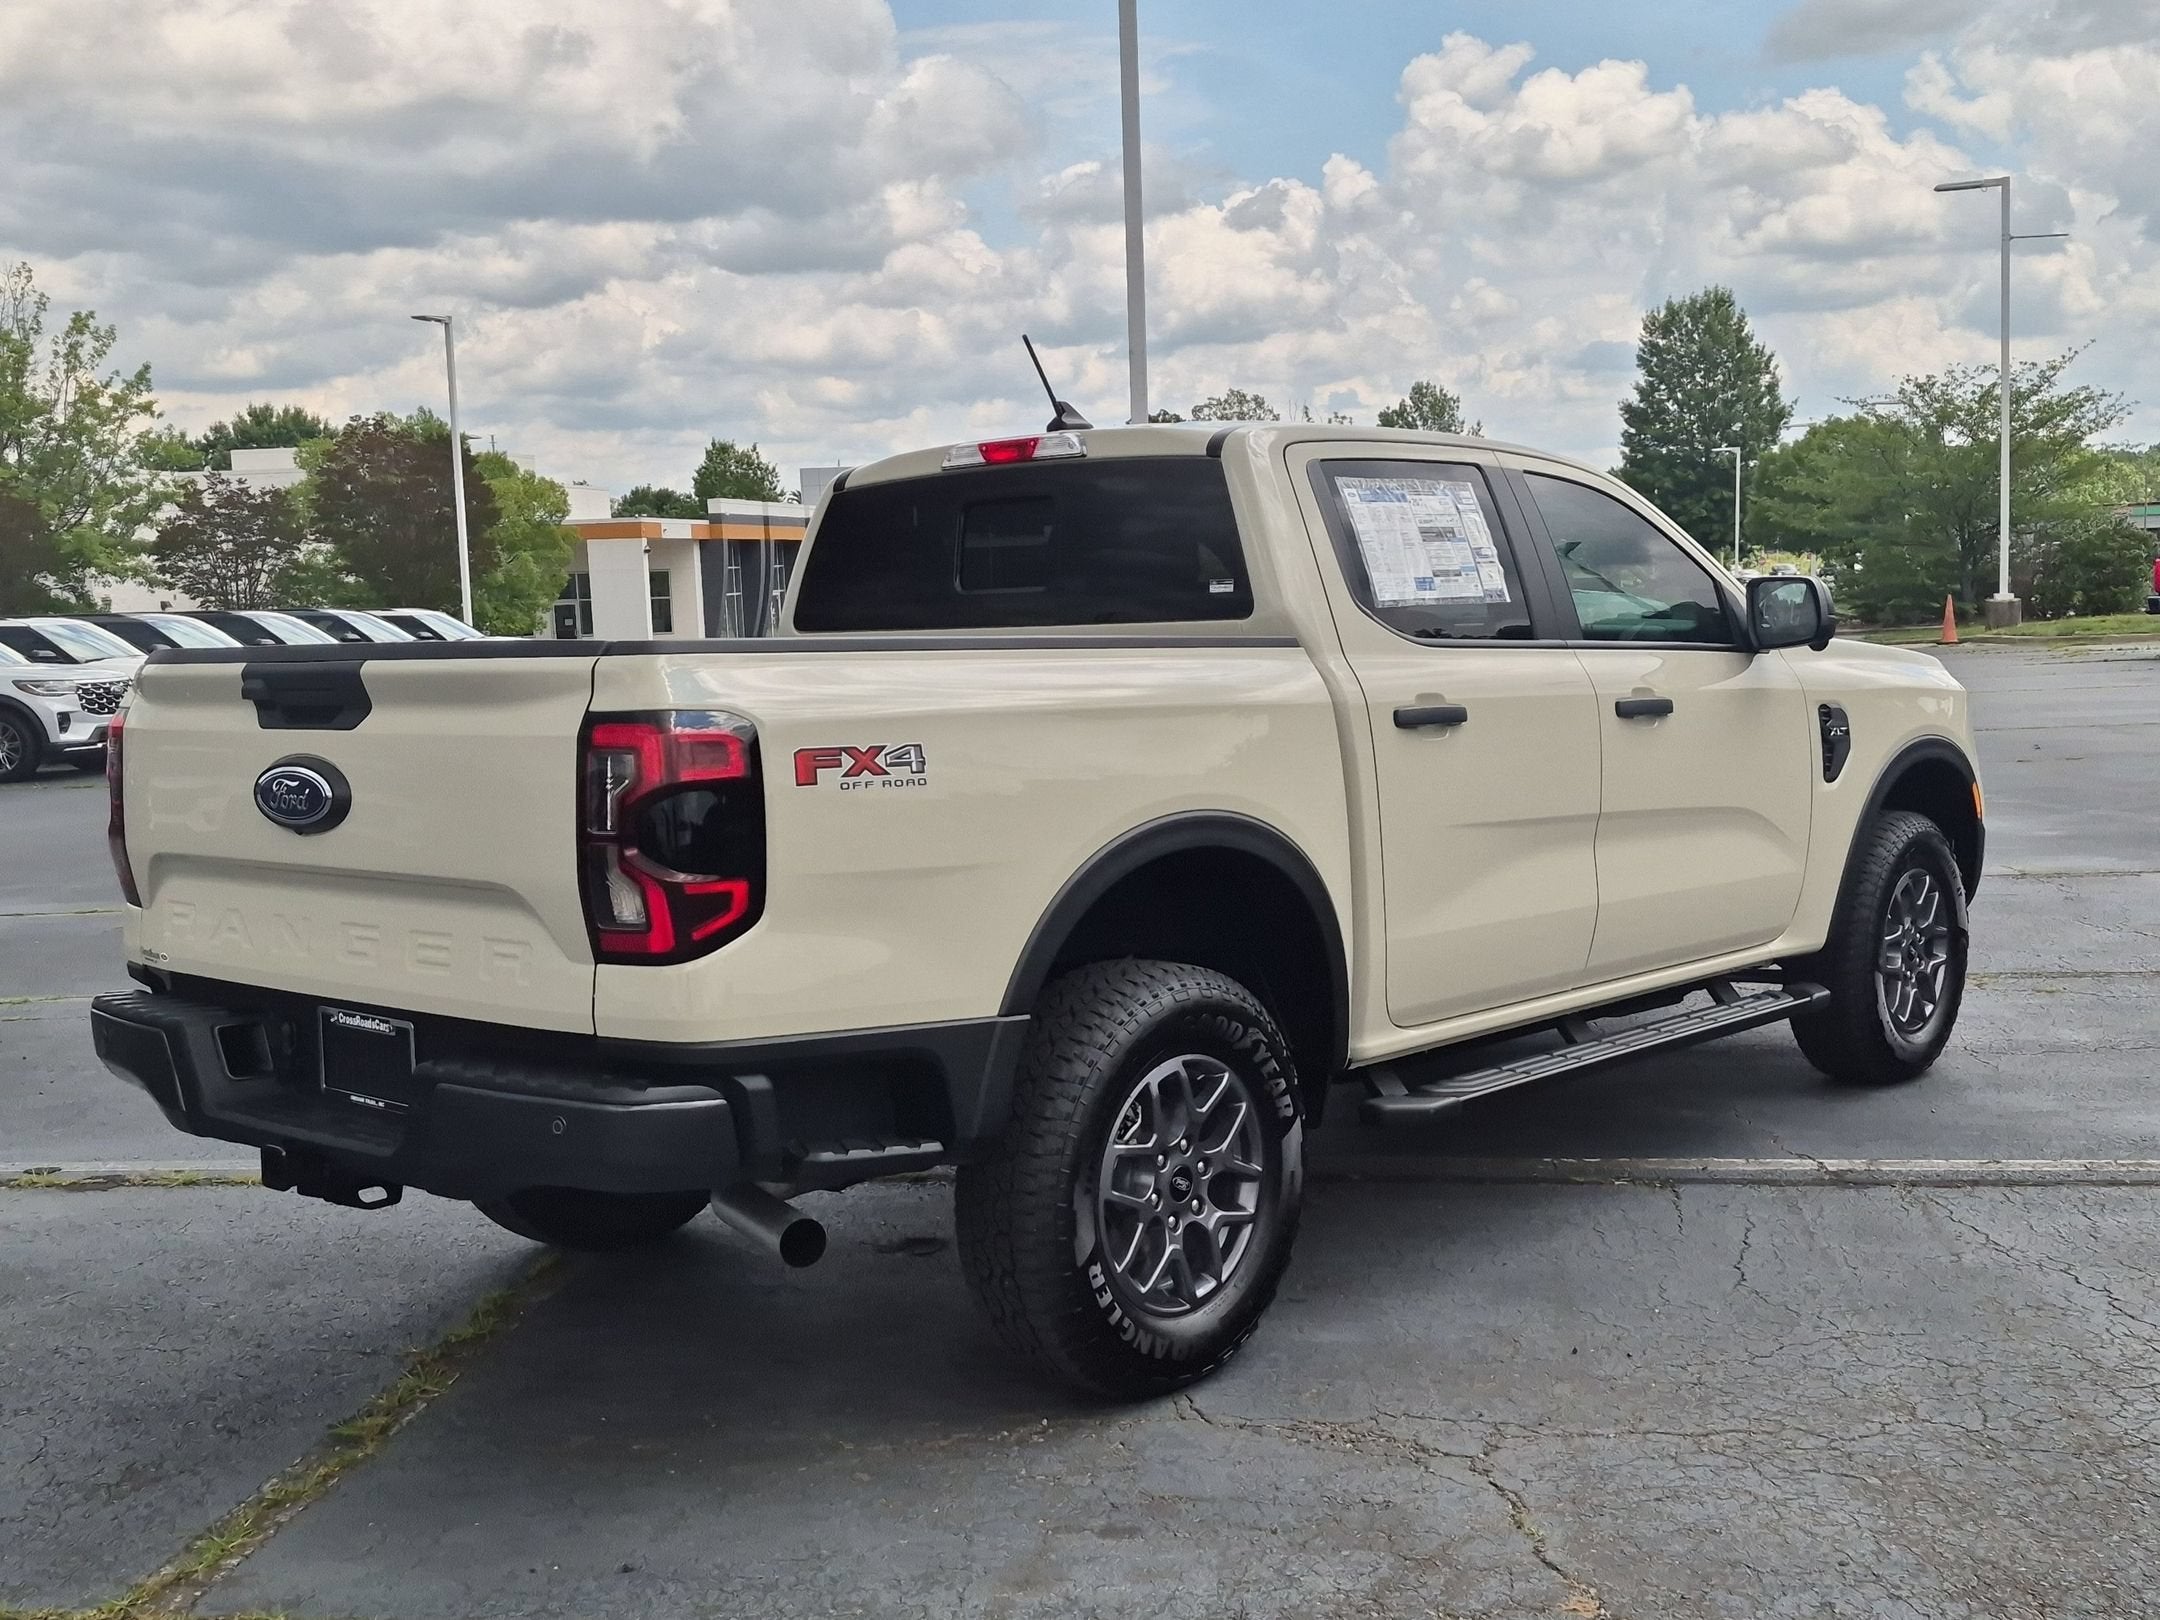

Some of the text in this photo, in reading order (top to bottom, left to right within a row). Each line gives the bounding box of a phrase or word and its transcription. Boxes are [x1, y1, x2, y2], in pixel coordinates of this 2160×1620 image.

[794, 744, 926, 786] FX4
[840, 778, 927, 790] OFF ROAD
[270, 778, 310, 810] Ford
[163, 901, 533, 987] RANGER
[1088, 1261, 1190, 1361] RANGLER
